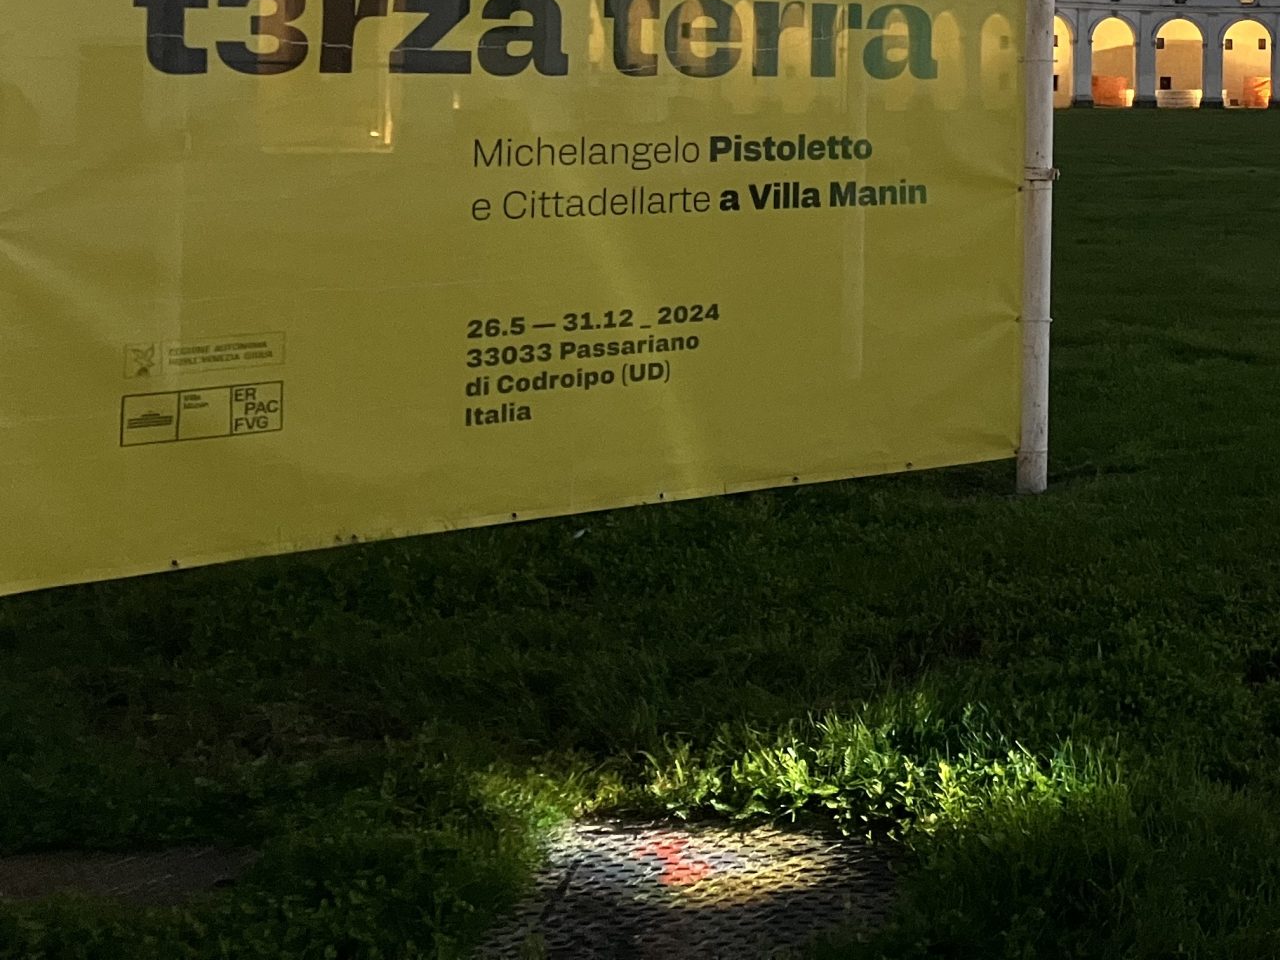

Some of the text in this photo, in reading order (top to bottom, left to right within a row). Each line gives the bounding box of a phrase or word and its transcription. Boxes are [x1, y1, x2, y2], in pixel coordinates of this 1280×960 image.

[473, 134, 873, 170] Michelangelo Pistoletto
[472, 178, 927, 221] e Cittadellarte a Villa Manin
[466, 316, 526, 338] 26.5
[563, 309, 633, 332] 31.12
[657, 304, 720, 325] 2024
[466, 334, 699, 368] 33033 Passariano
[234, 387, 256, 402] ER
[465, 360, 671, 397] di Codroipo (UD)
[234, 415, 269, 432] FVG
[244, 399, 279, 415] PAC
[465, 402, 532, 427] Italia
